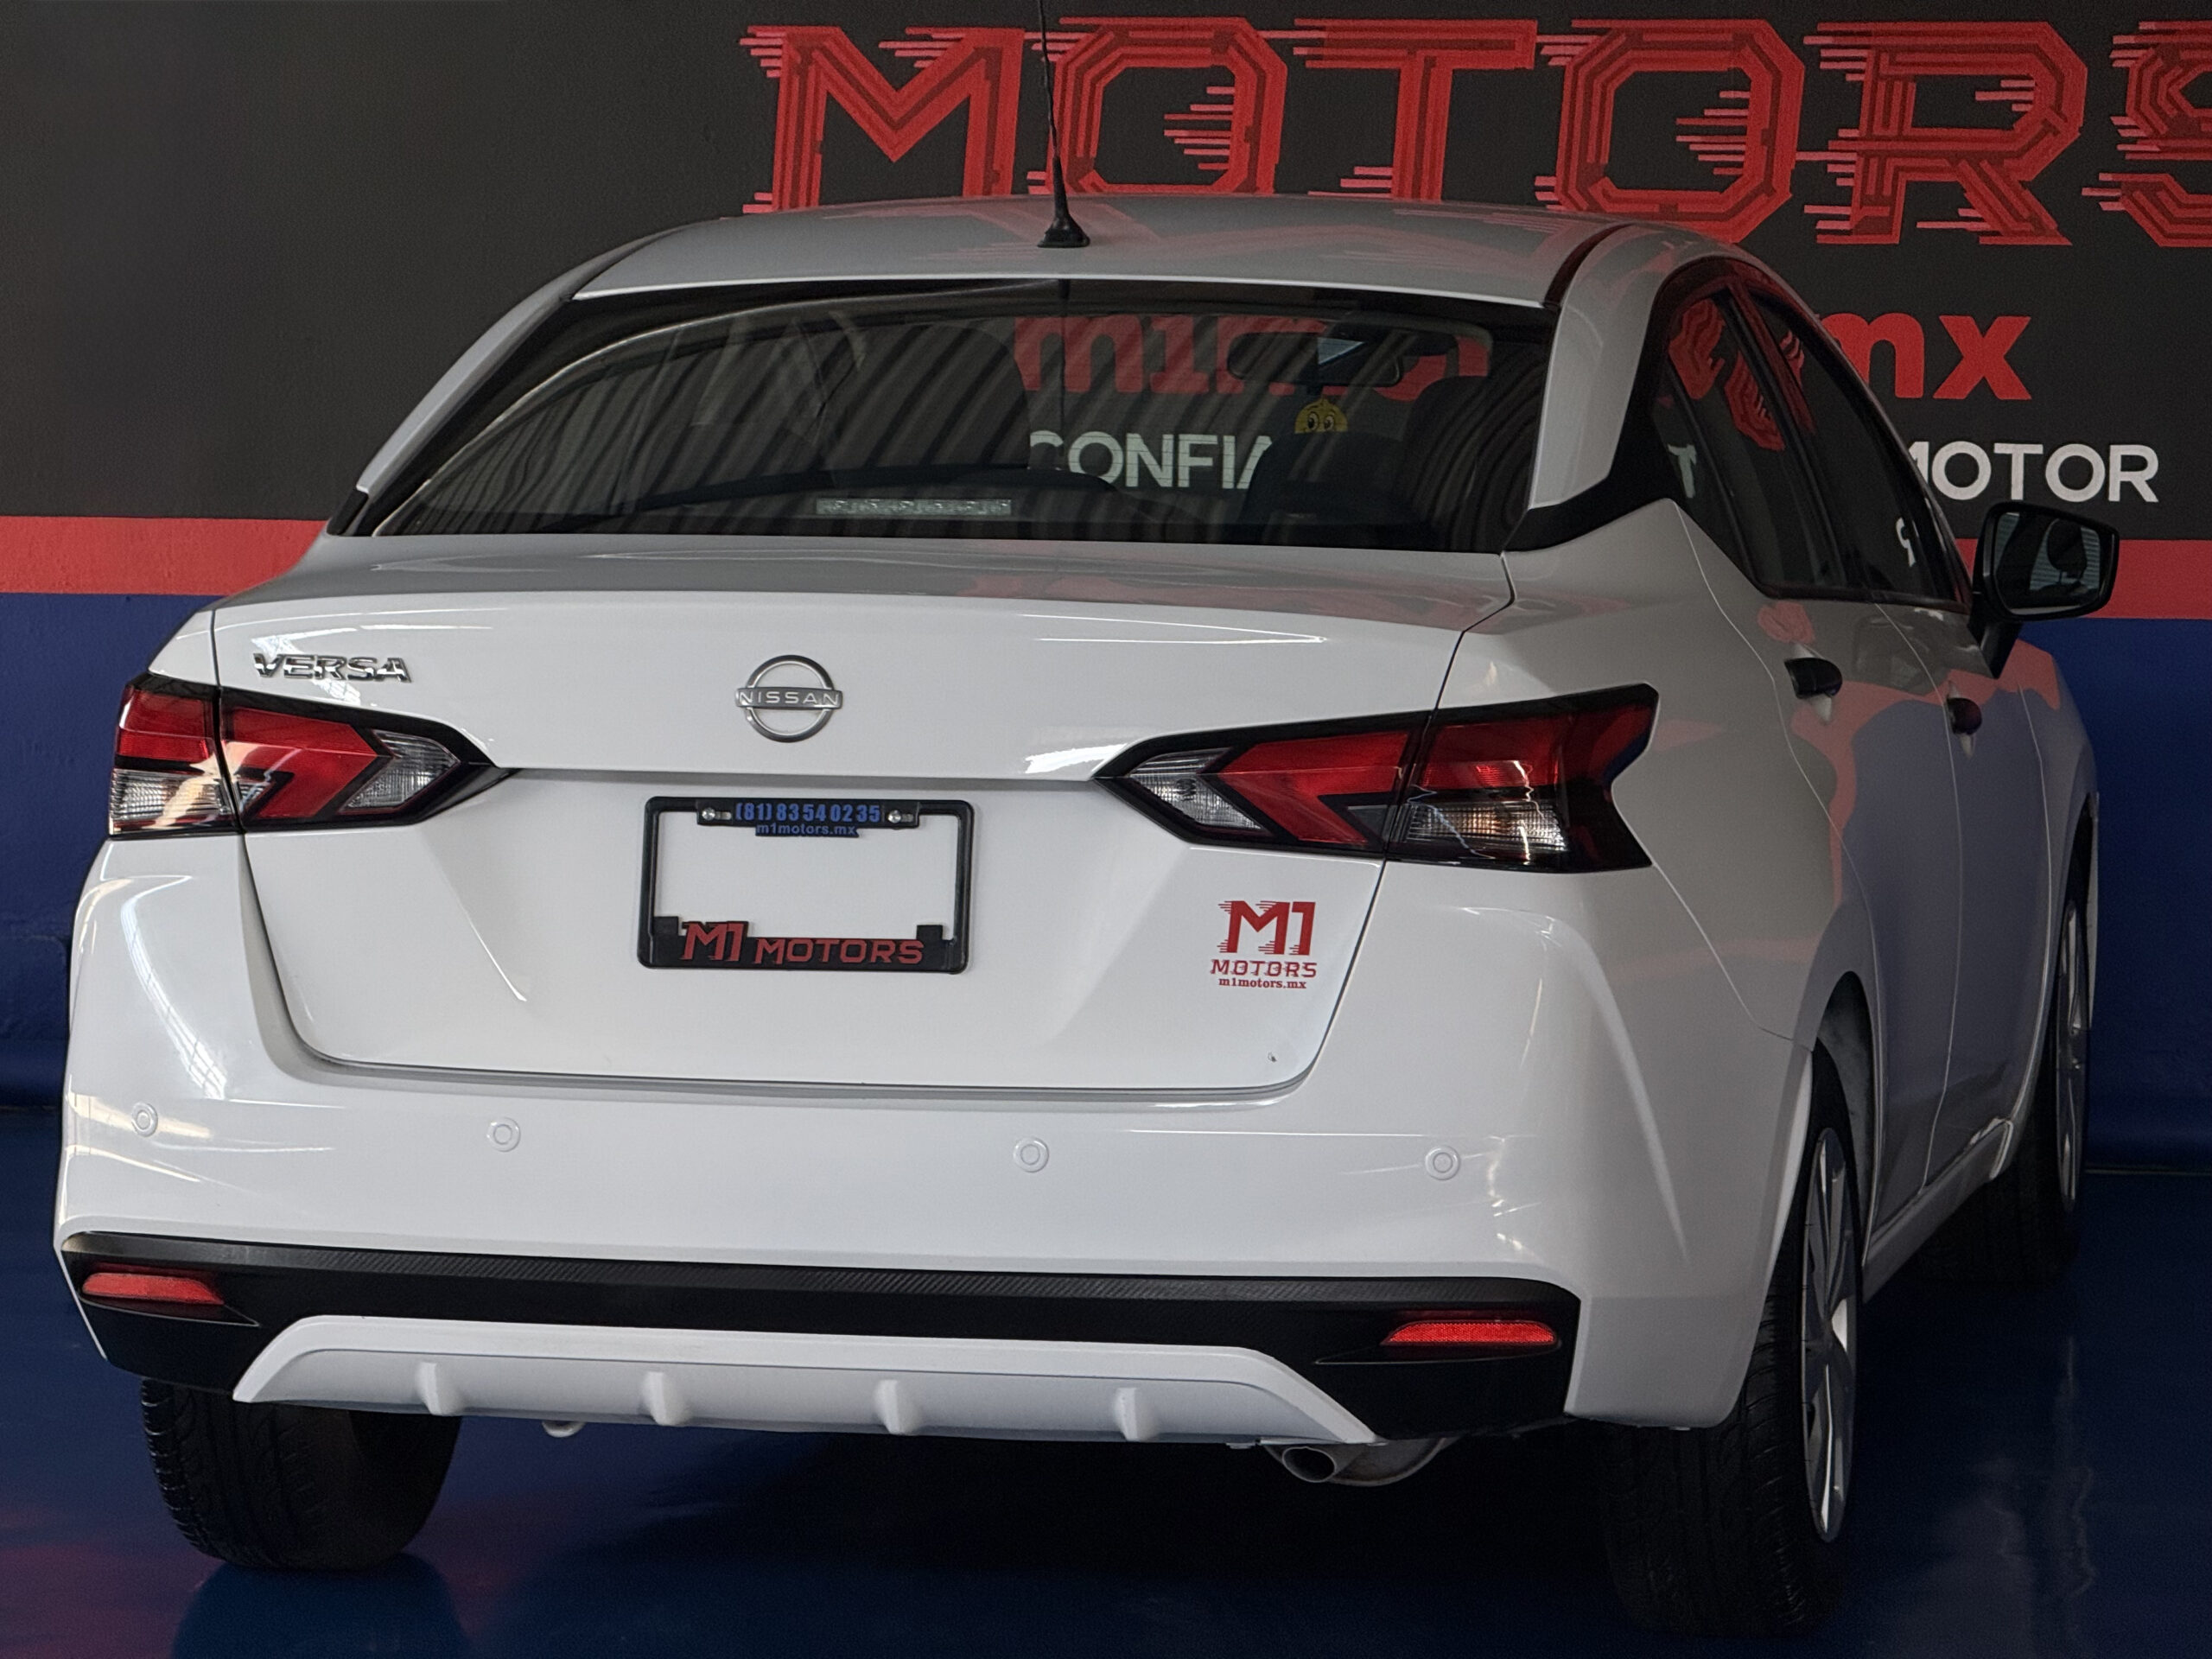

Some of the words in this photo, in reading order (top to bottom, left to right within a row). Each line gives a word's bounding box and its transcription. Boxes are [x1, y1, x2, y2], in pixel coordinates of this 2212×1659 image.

[253, 652, 412, 683] VERSA
[739, 691, 840, 707] NISSAN
[735, 803, 772, 821] (81)
[756, 822, 856, 836] m1motors.mx
[1217, 900, 1316, 956] M1
[681, 921, 747, 962] M1
[754, 938, 925, 964] MOTORS
[1210, 959, 1318, 978] MOTORS
[1218, 977, 1307, 989] m1motors.mx
